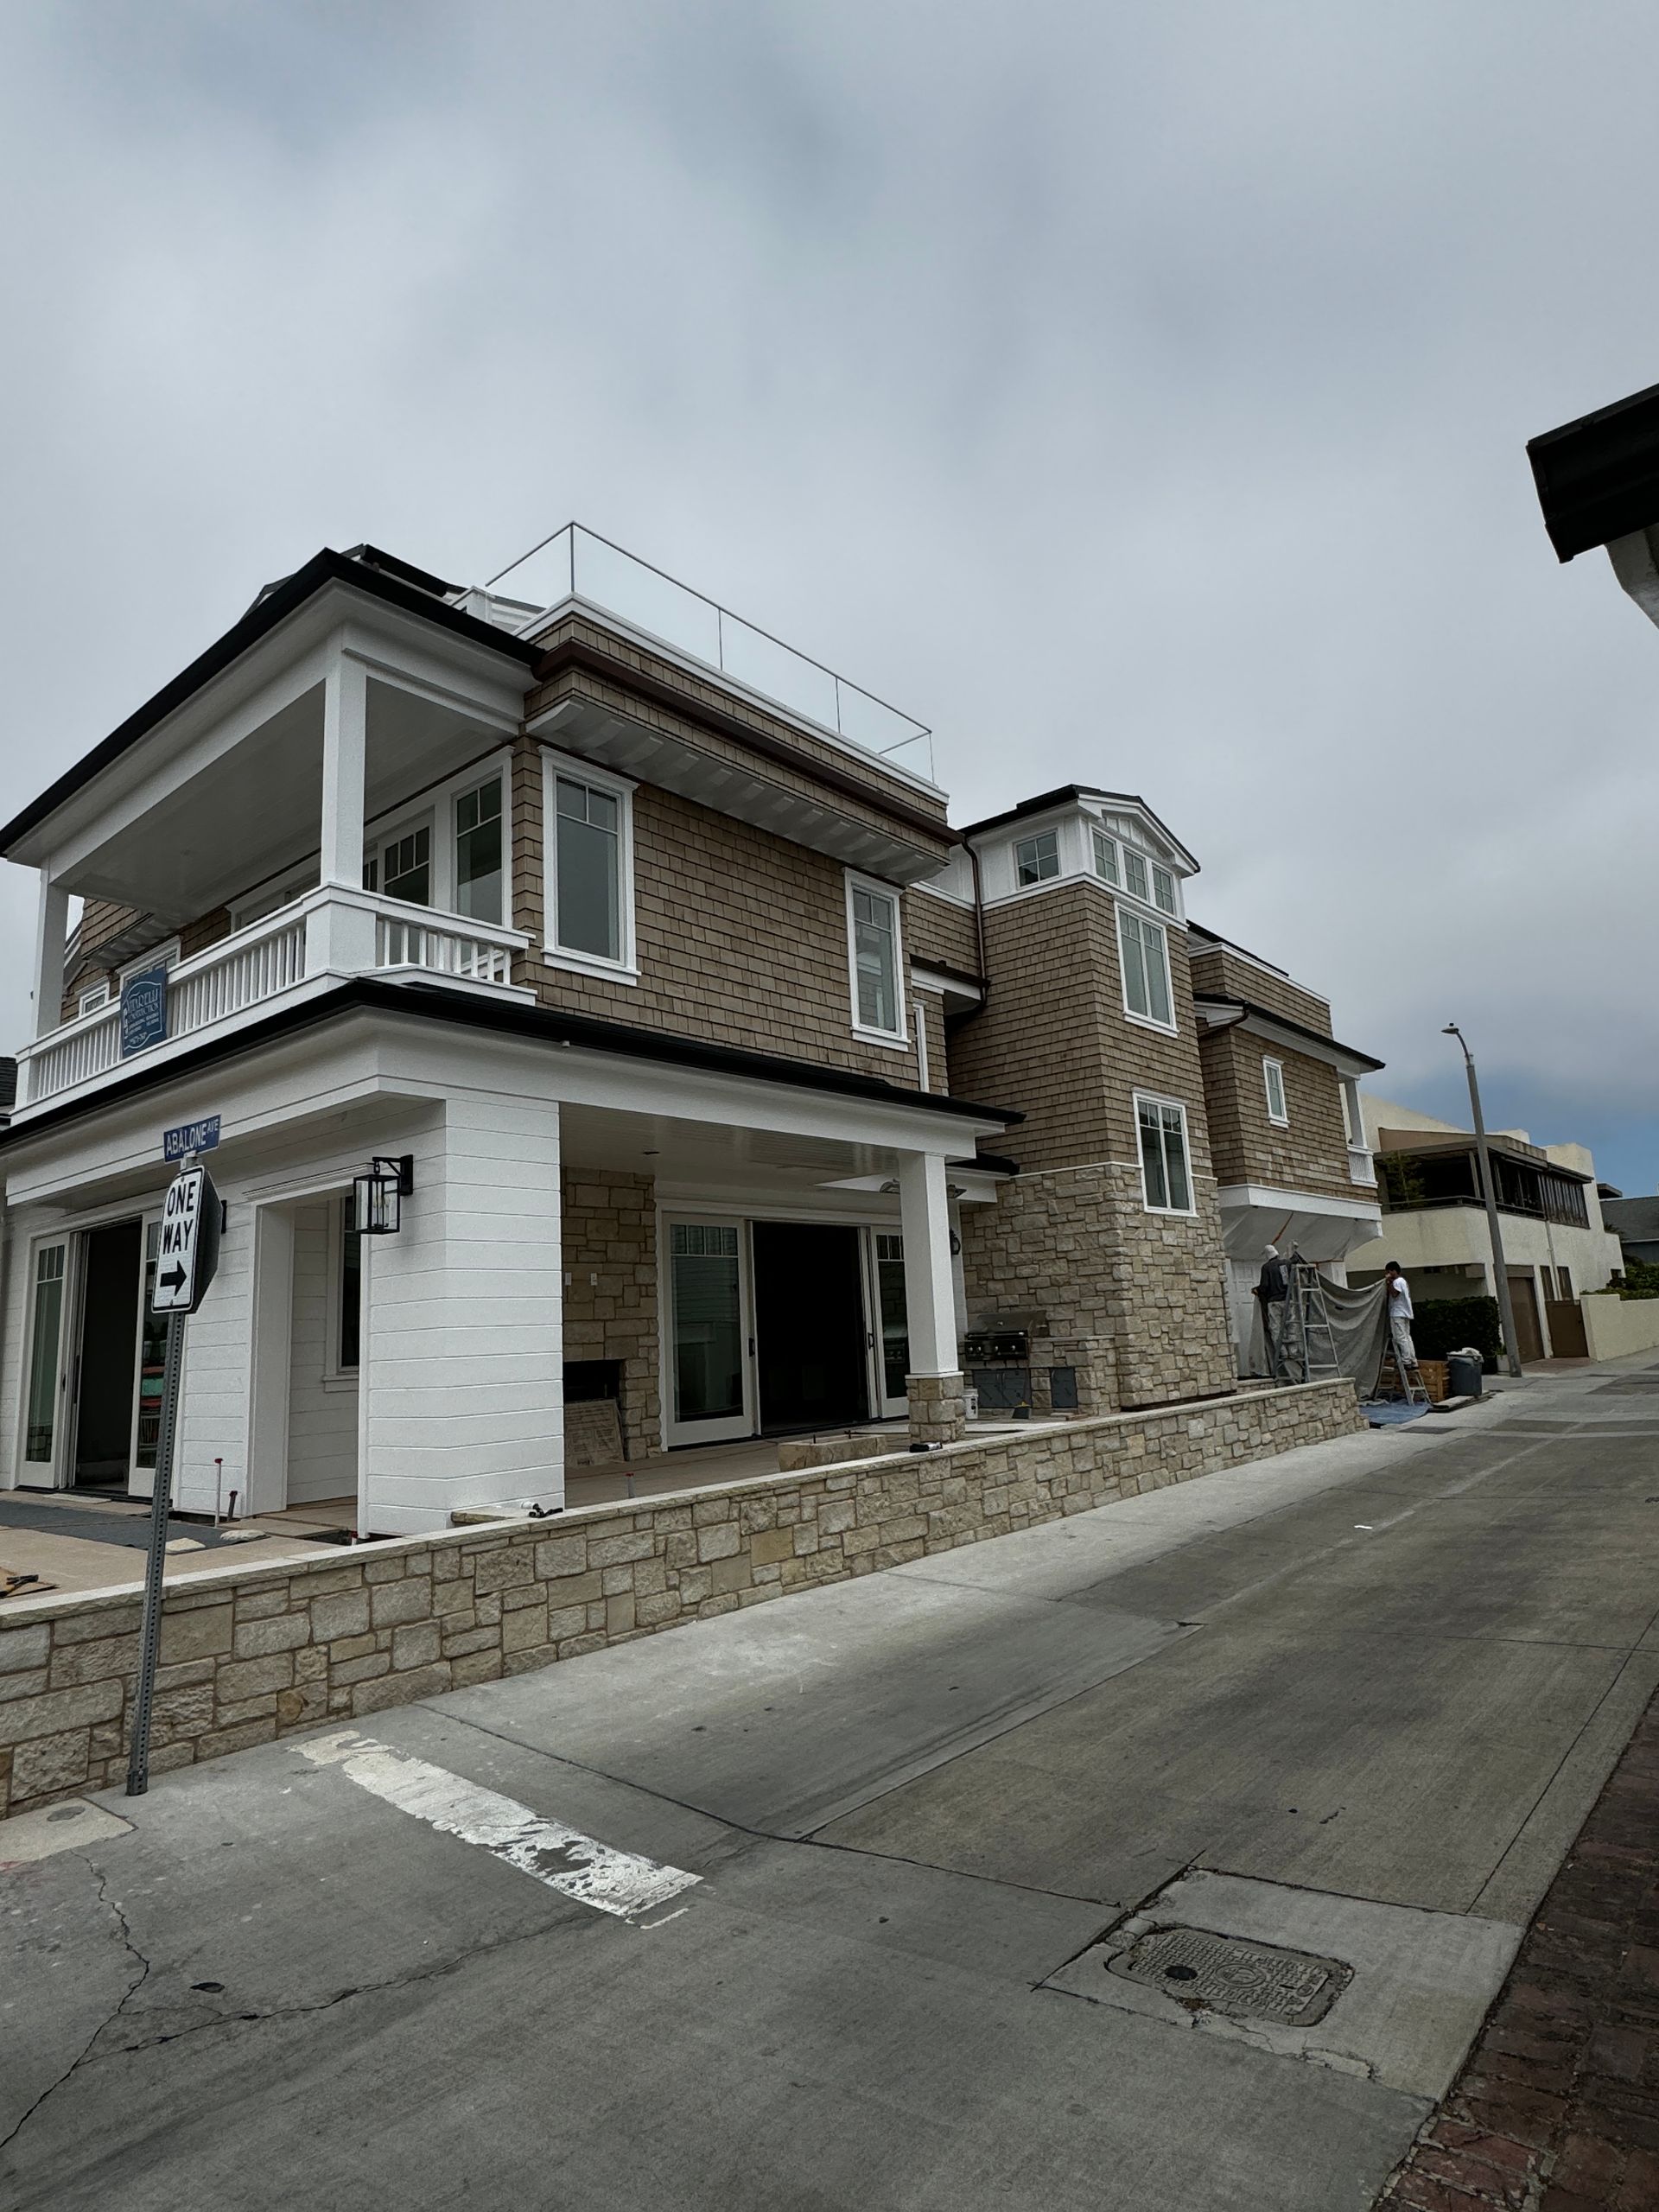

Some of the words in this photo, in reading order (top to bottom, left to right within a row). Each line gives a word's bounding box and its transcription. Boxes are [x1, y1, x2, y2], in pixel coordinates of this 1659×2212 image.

[166, 1123, 207, 1156] ABALONE
[207, 1119, 219, 1135] AVE
[167, 1180, 196, 1217] ONE
[162, 1219, 194, 1255] WAY
